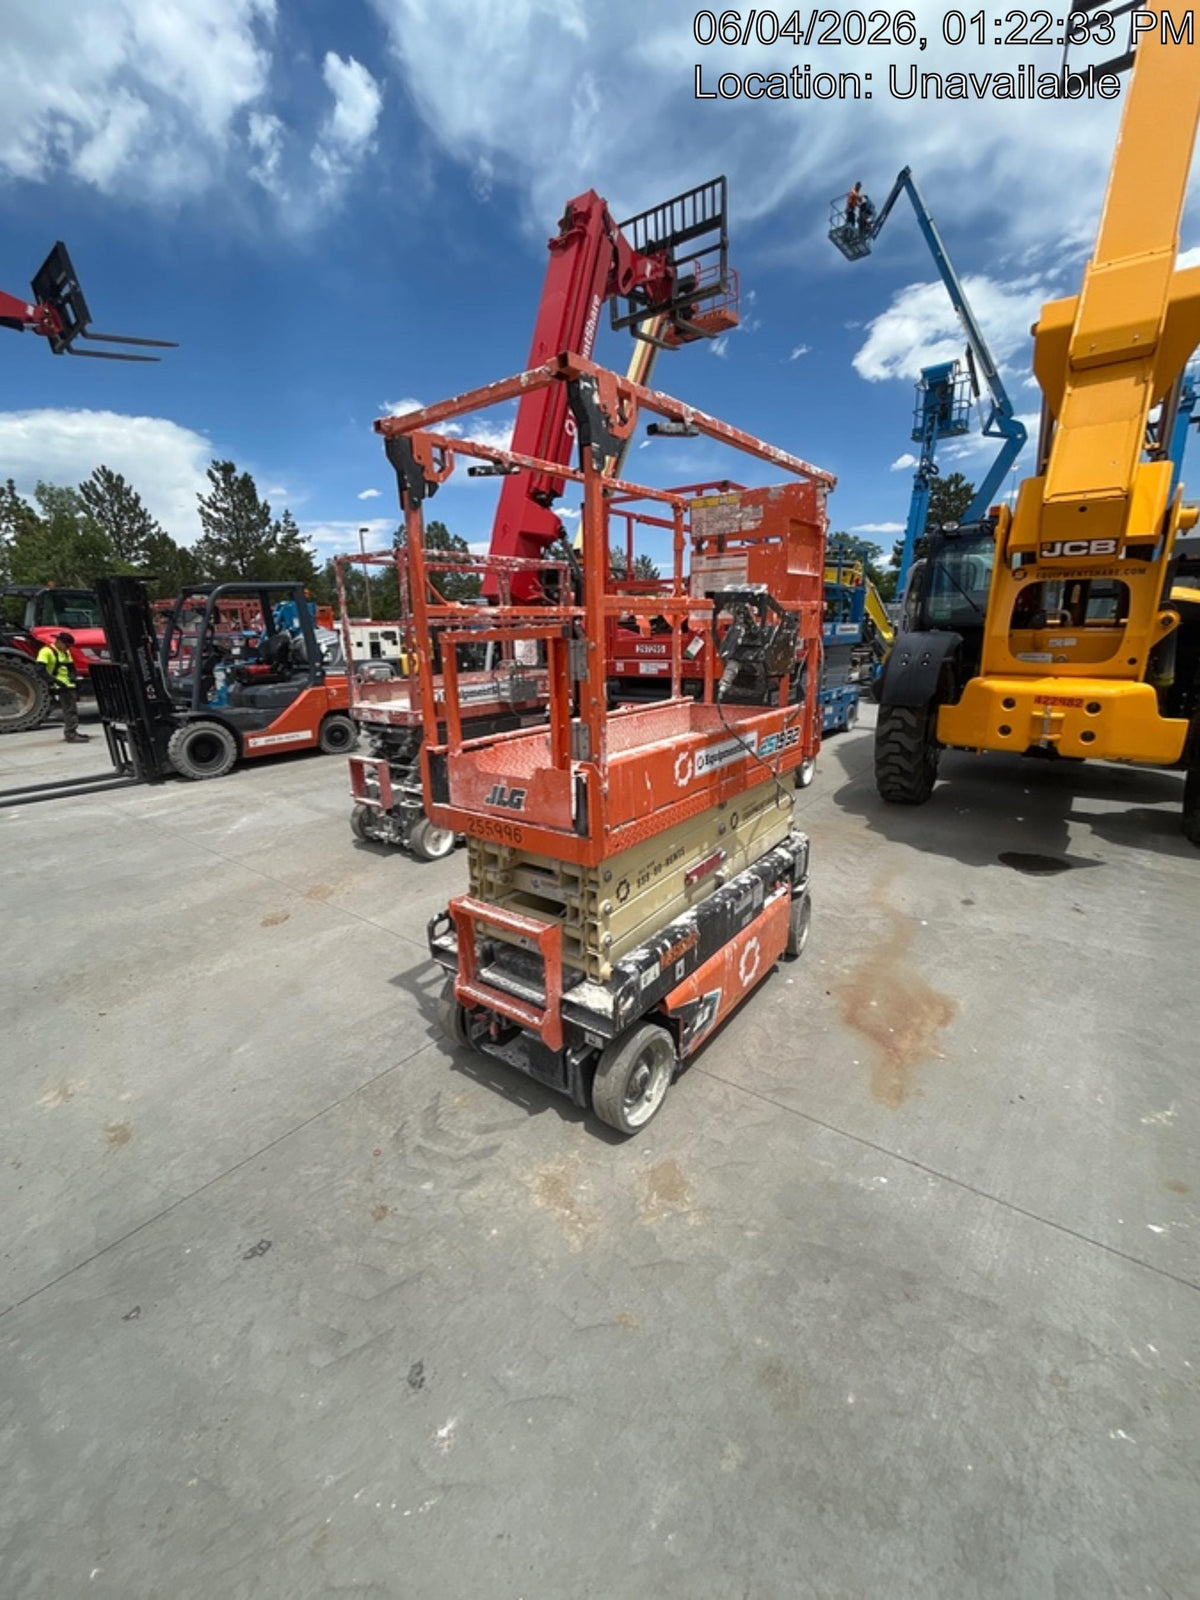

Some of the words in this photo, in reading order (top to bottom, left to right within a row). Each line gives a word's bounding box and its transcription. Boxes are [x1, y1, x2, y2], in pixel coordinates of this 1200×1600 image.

[1041, 539, 1116, 557] JCB
[485, 784, 527, 810] JLG
[467, 818, 523, 844] 255996
